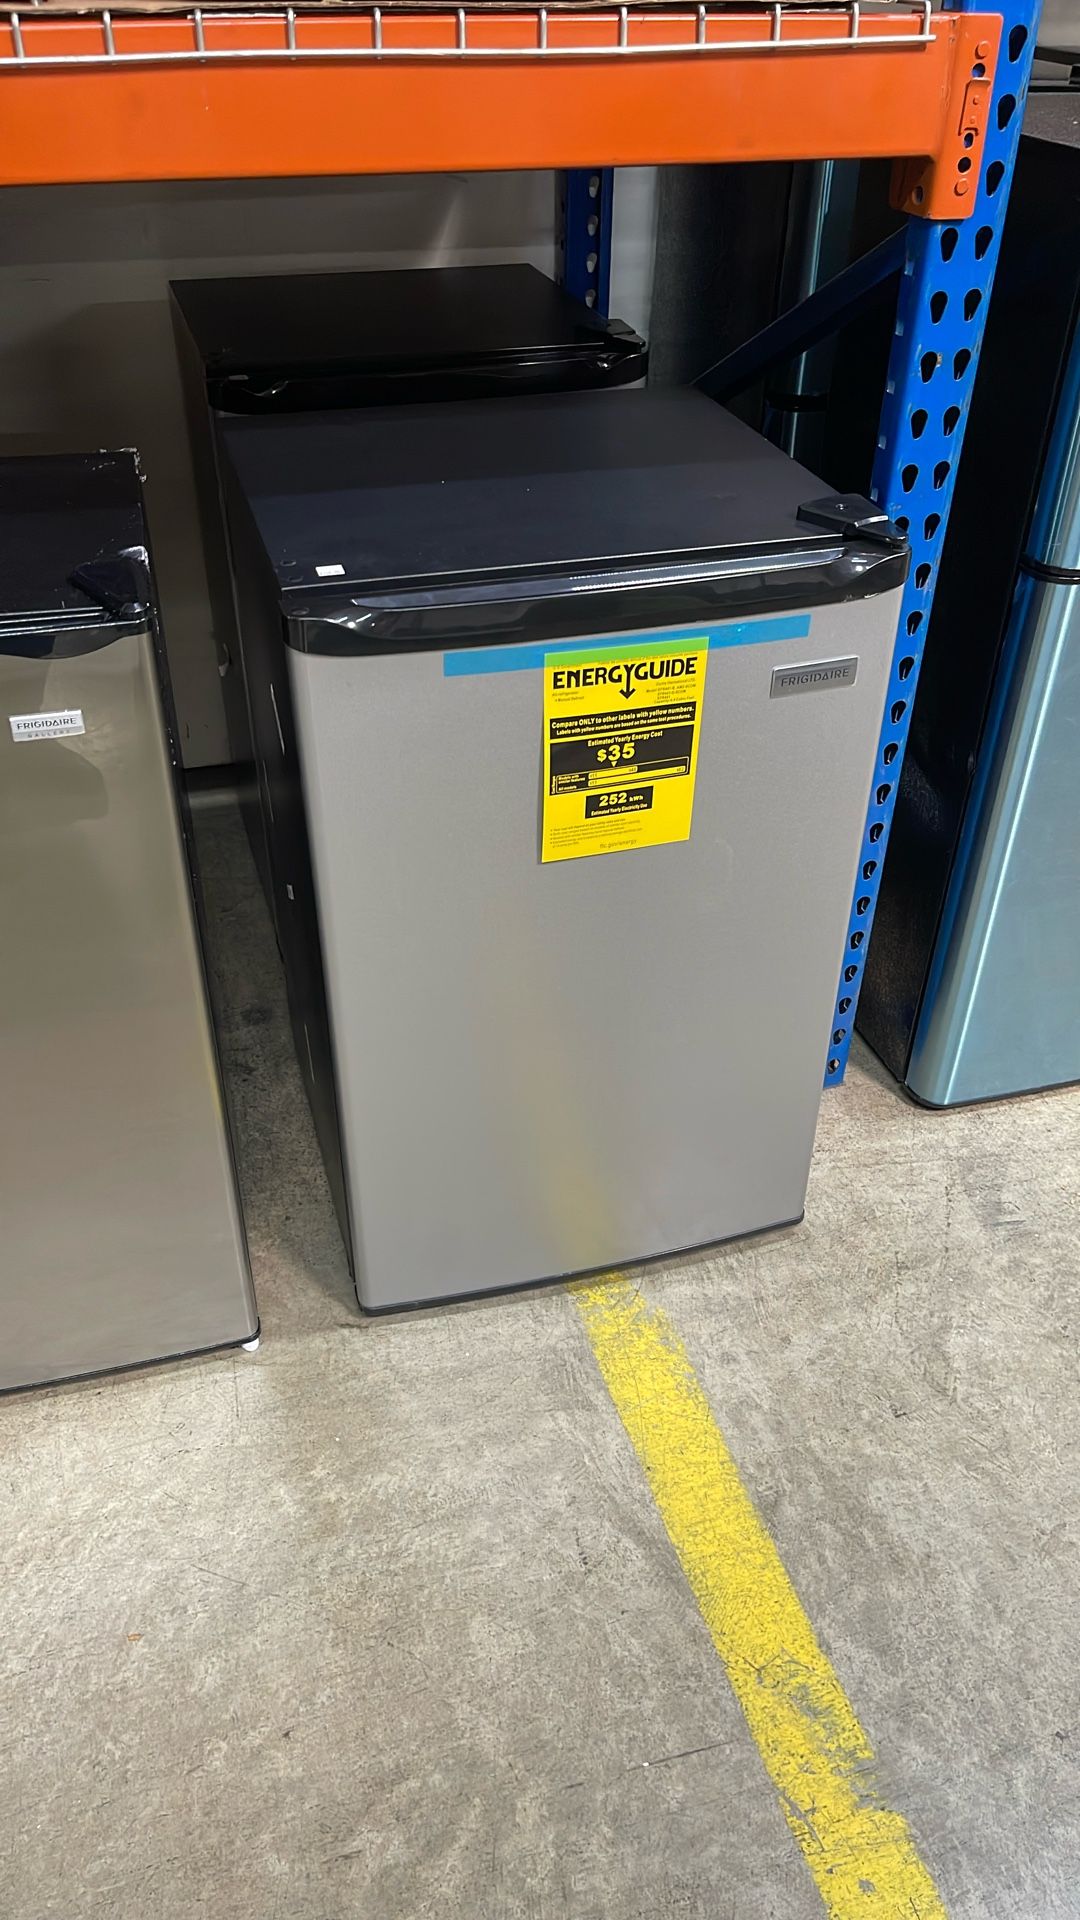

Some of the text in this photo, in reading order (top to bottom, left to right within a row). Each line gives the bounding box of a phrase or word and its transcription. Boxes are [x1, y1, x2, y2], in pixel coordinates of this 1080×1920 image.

[553, 657, 698, 690] ENERGYGUIDE
[781, 667, 849, 687] FRIGIDAIRE
[17, 717, 77, 730] FRIGIDAIRE
[552, 721, 578, 729] Compare
[579, 717, 595, 726] ONLY
[618, 713, 635, 721] labels
[649, 709, 667, 718] yellow
[668, 706, 694, 714] numbers.
[581, 726, 595, 734] yellow
[587, 730, 663, 747] Estimated Yearly Energy Cost
[597, 742, 635, 762] $35
[599, 792, 627, 807] 252
